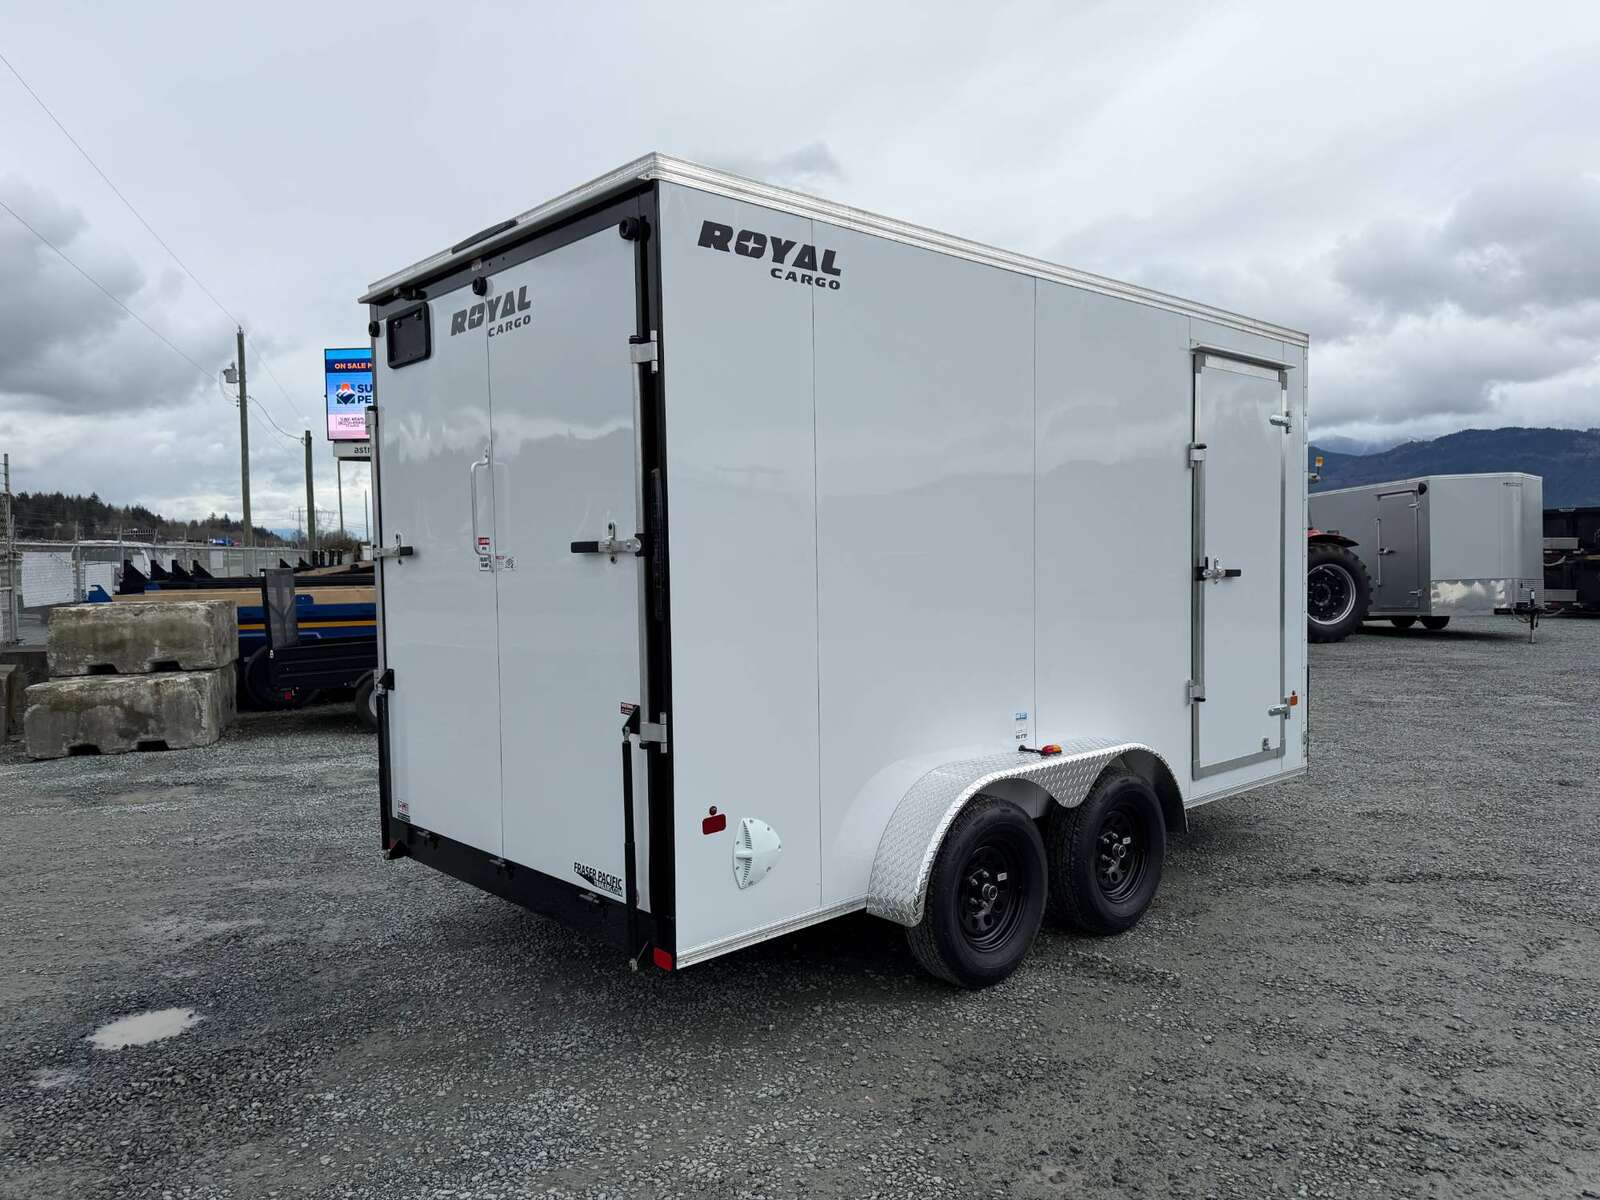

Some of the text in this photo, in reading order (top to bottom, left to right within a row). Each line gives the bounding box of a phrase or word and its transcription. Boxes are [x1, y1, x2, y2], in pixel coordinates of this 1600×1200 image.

[698, 220, 841, 276] ROYAL
[770, 268, 841, 290] CARGO
[451, 285, 531, 336] ROYAL
[488, 315, 531, 337] CARGO
[574, 862, 597, 881] FRASER
[598, 871, 623, 892] PACIFIC
